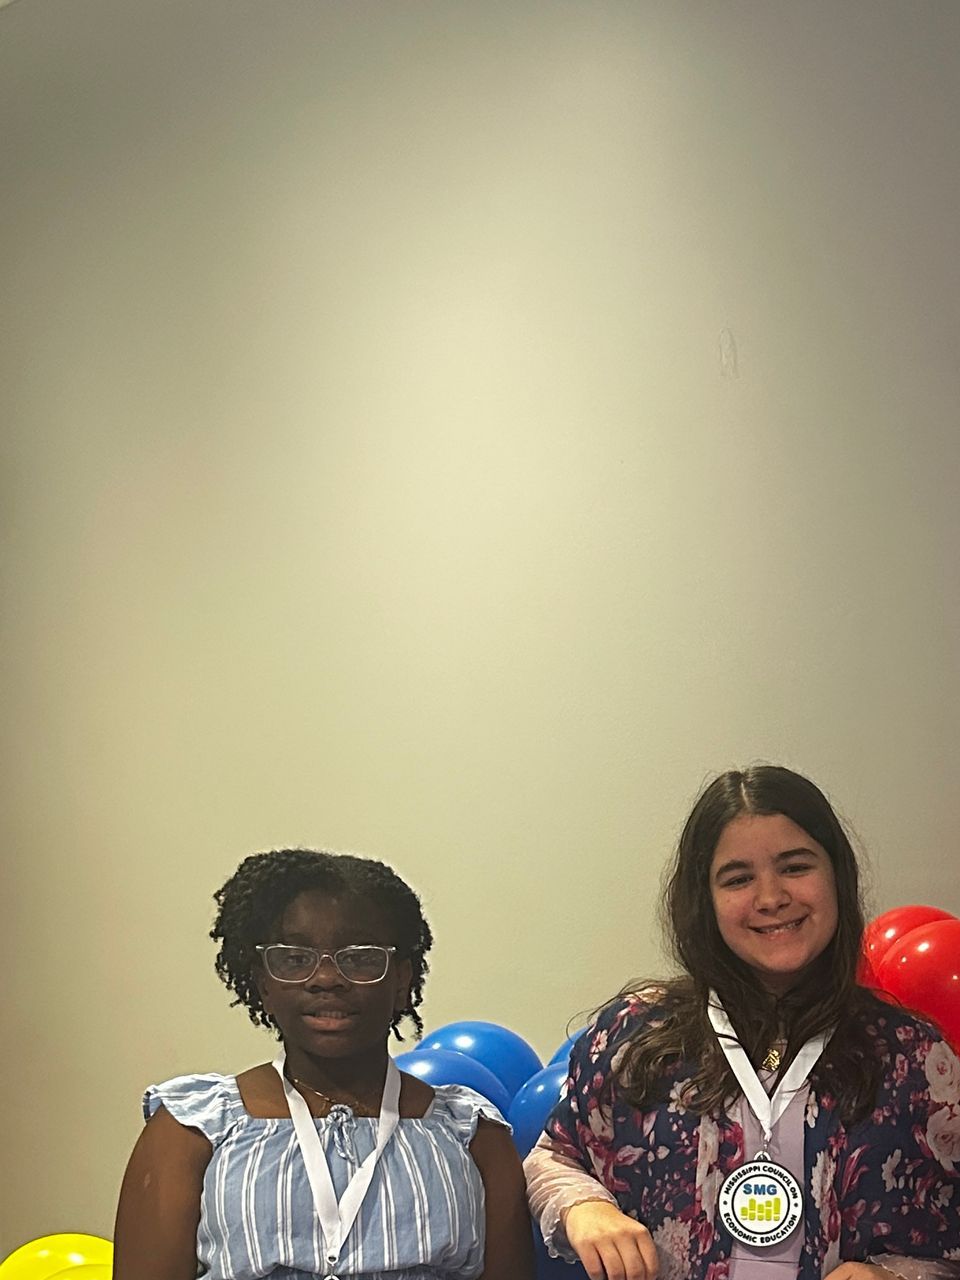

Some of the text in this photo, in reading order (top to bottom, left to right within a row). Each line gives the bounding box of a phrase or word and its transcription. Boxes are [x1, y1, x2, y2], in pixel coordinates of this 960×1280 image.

[724, 1166, 798, 1198] MISSISSIPPI COUNCIL ON
[743, 1184, 777, 1195] SMG
[724, 1213, 797, 1243] ECONOMIC EDUCATION
